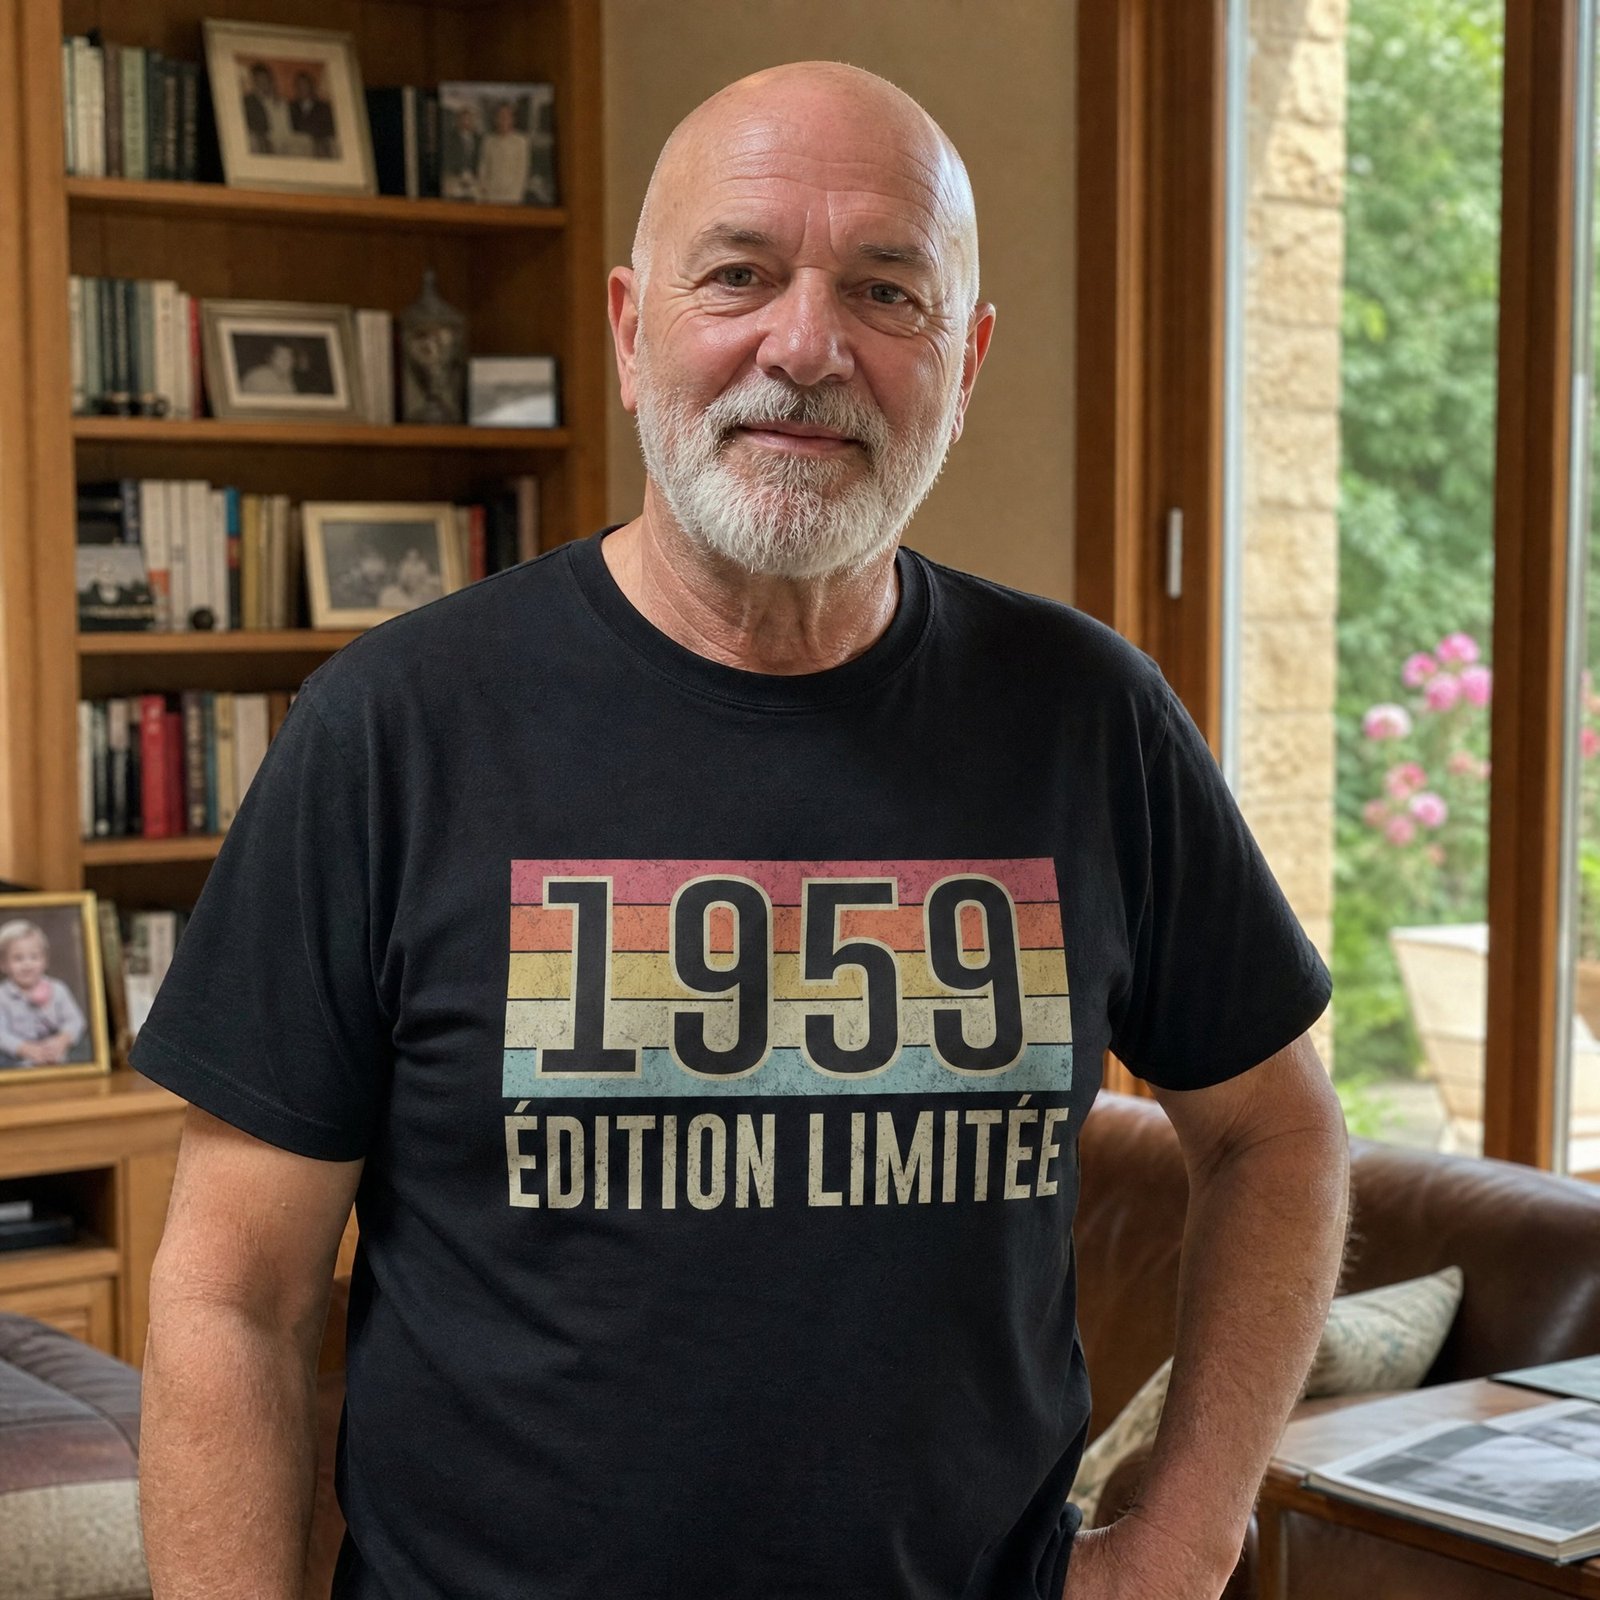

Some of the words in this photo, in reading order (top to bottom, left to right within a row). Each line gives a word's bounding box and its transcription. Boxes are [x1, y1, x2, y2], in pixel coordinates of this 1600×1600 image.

[536, 874, 1028, 1079] 1959
[504, 1101, 775, 1210] ÉDITION
[808, 1095, 1069, 1206] LIMITÉE
